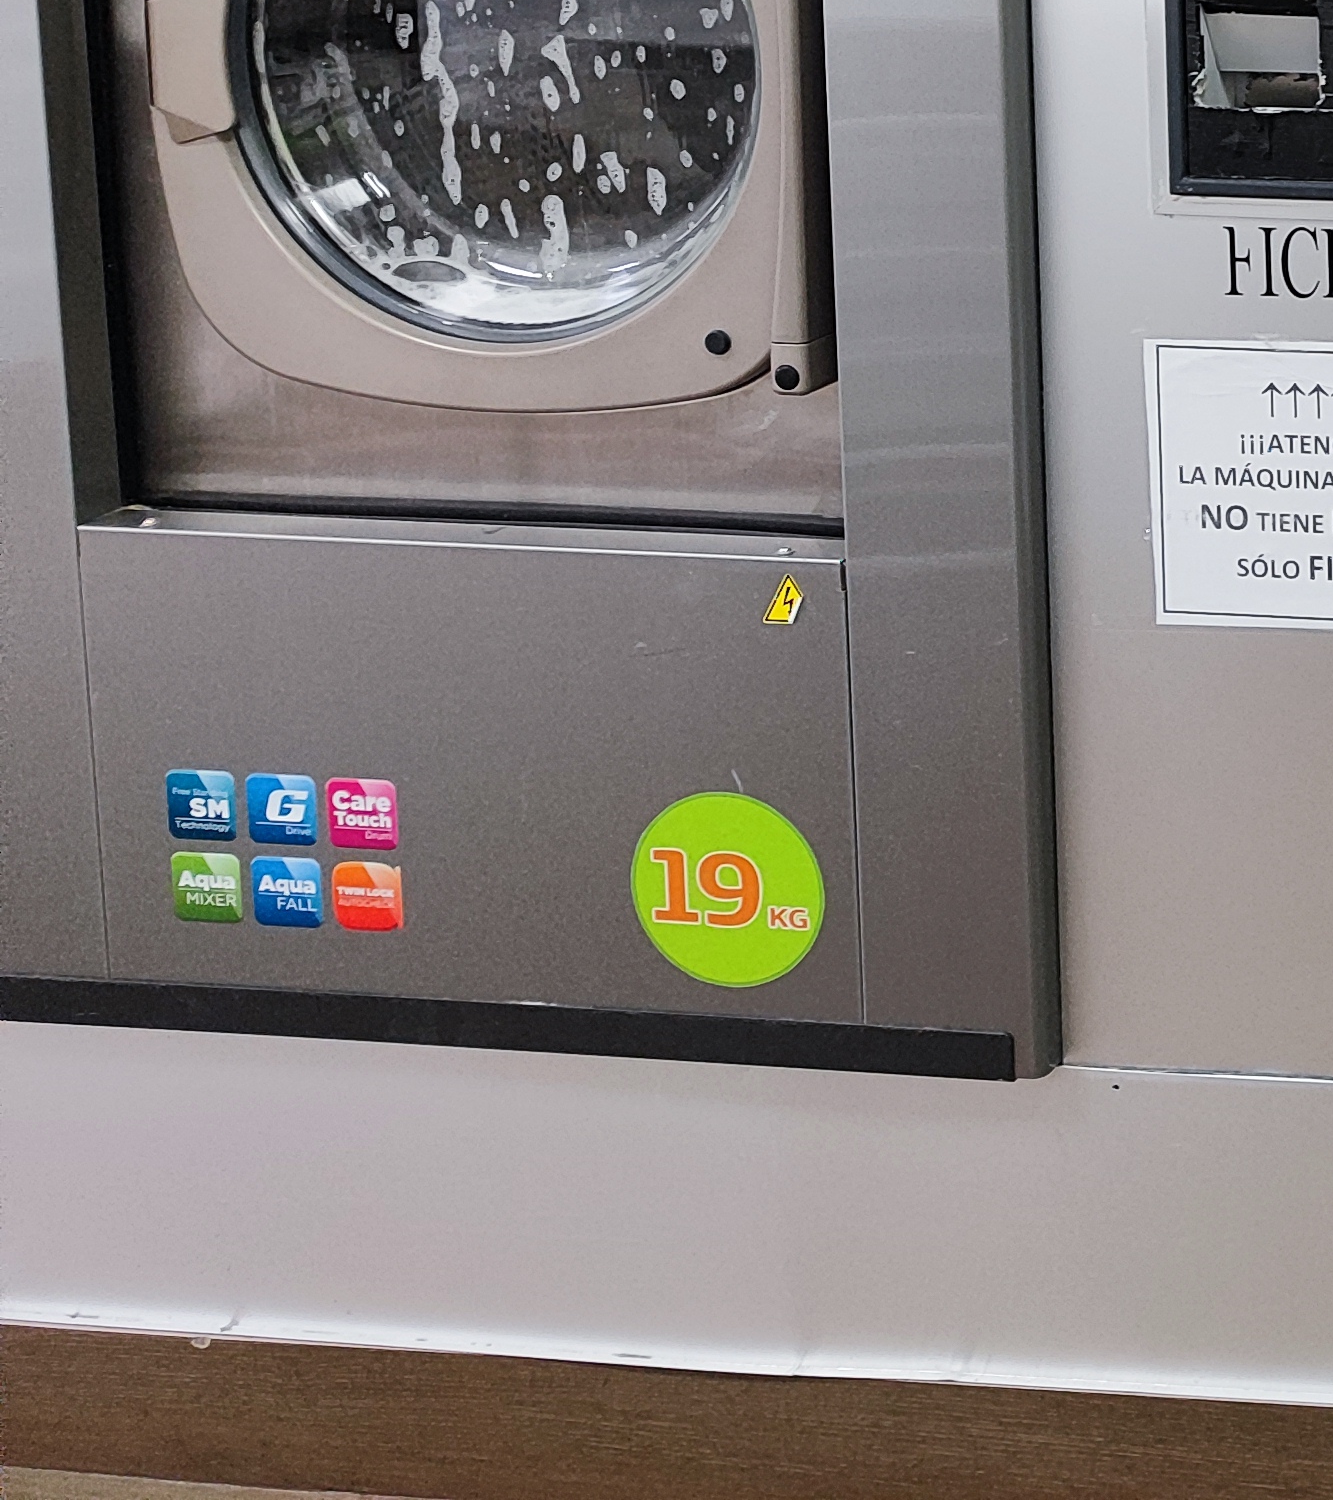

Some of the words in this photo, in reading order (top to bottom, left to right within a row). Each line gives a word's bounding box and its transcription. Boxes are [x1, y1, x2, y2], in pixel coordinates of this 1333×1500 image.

[1179, 466, 1206, 484] LA
[1202, 505, 1248, 530] NO
[1256, 513, 1324, 533] TIENE
[1238, 554, 1299, 579] SÓLO
[331, 789, 391, 814] Care
[333, 809, 392, 829] Touch
[650, 848, 762, 928] 19
[768, 906, 810, 931] KG
